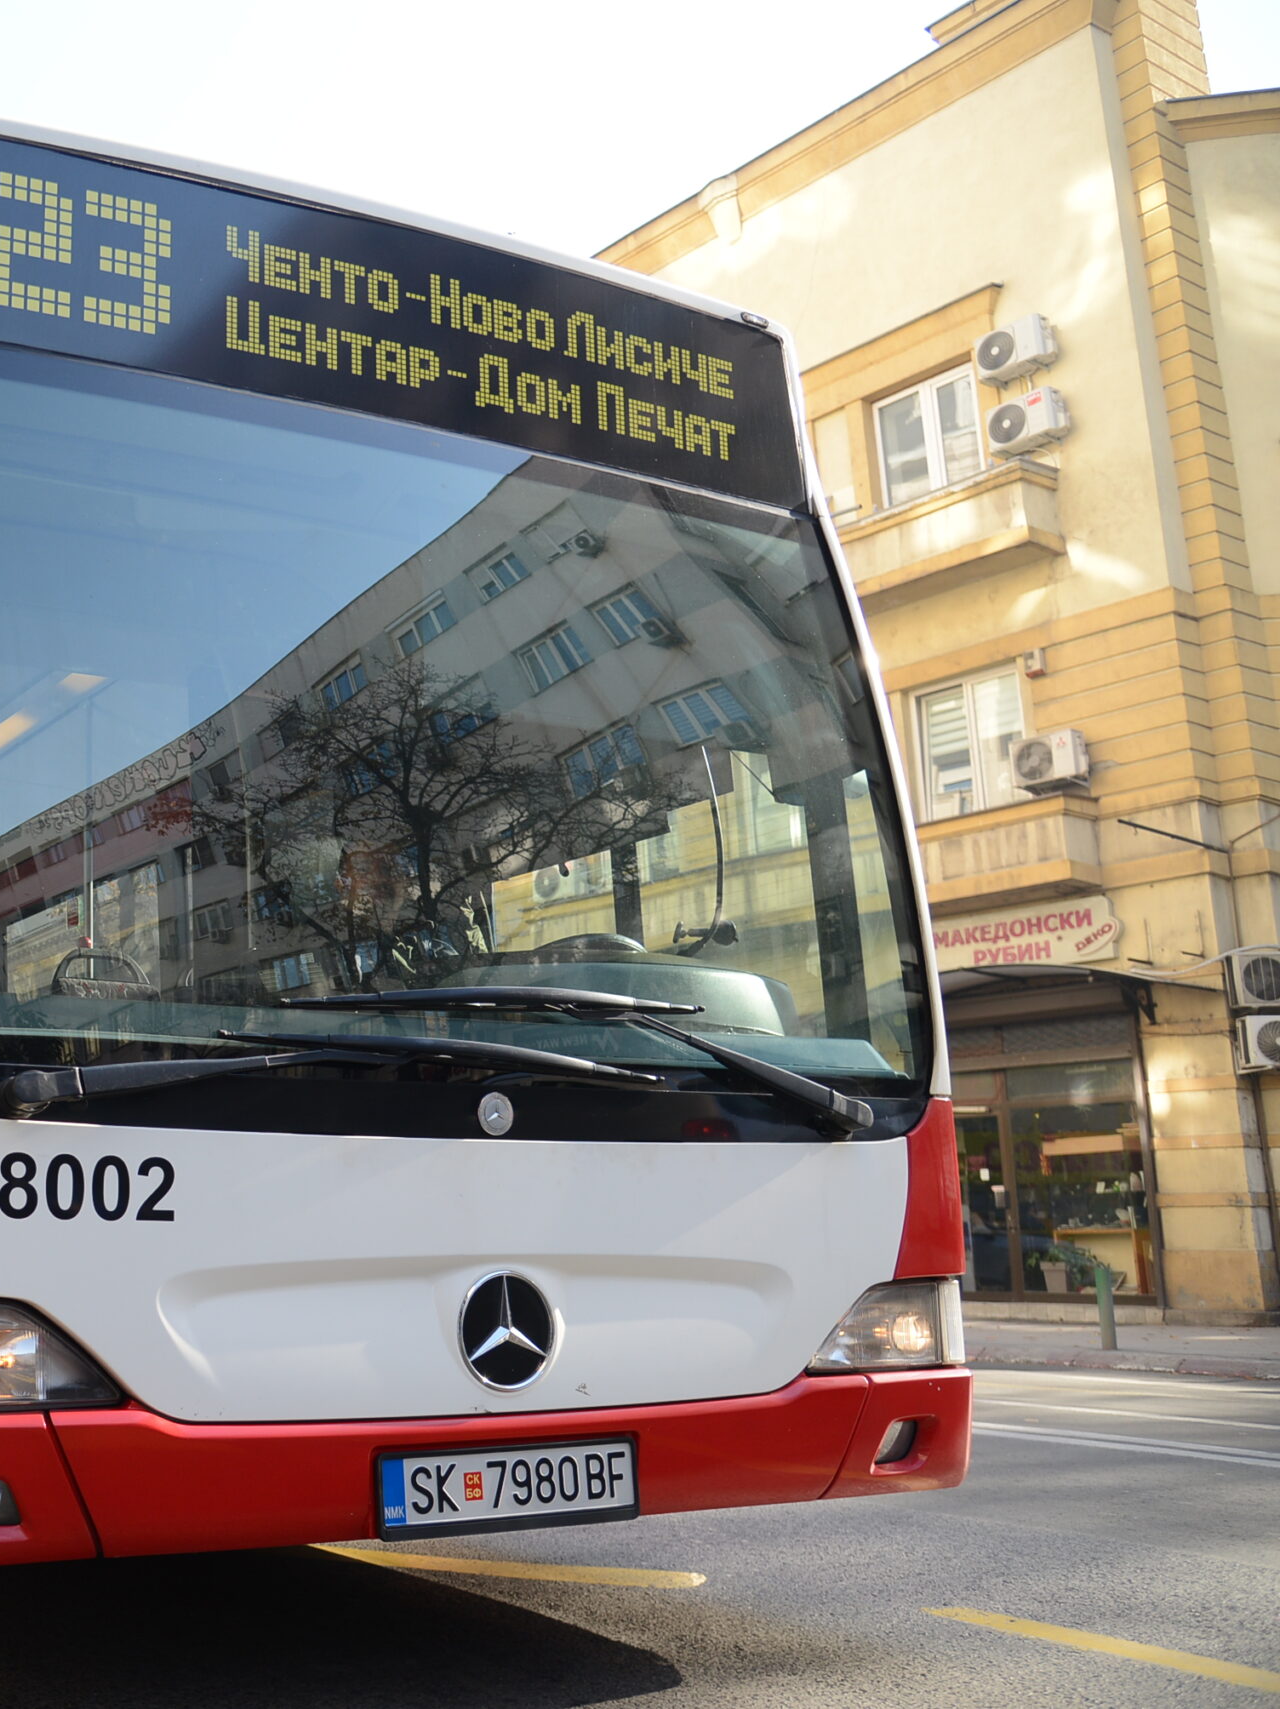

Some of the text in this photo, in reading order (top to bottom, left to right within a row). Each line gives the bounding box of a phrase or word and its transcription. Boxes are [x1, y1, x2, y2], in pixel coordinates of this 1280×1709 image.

[596, 381, 737, 463] ПЕЧАТ
[934, 908, 1093, 950] МАКЕДОНСКИ
[973, 940, 1052, 966] РУБИН
[410, 1463, 461, 1515] SK
[384, 1505, 405, 1519] NMK
